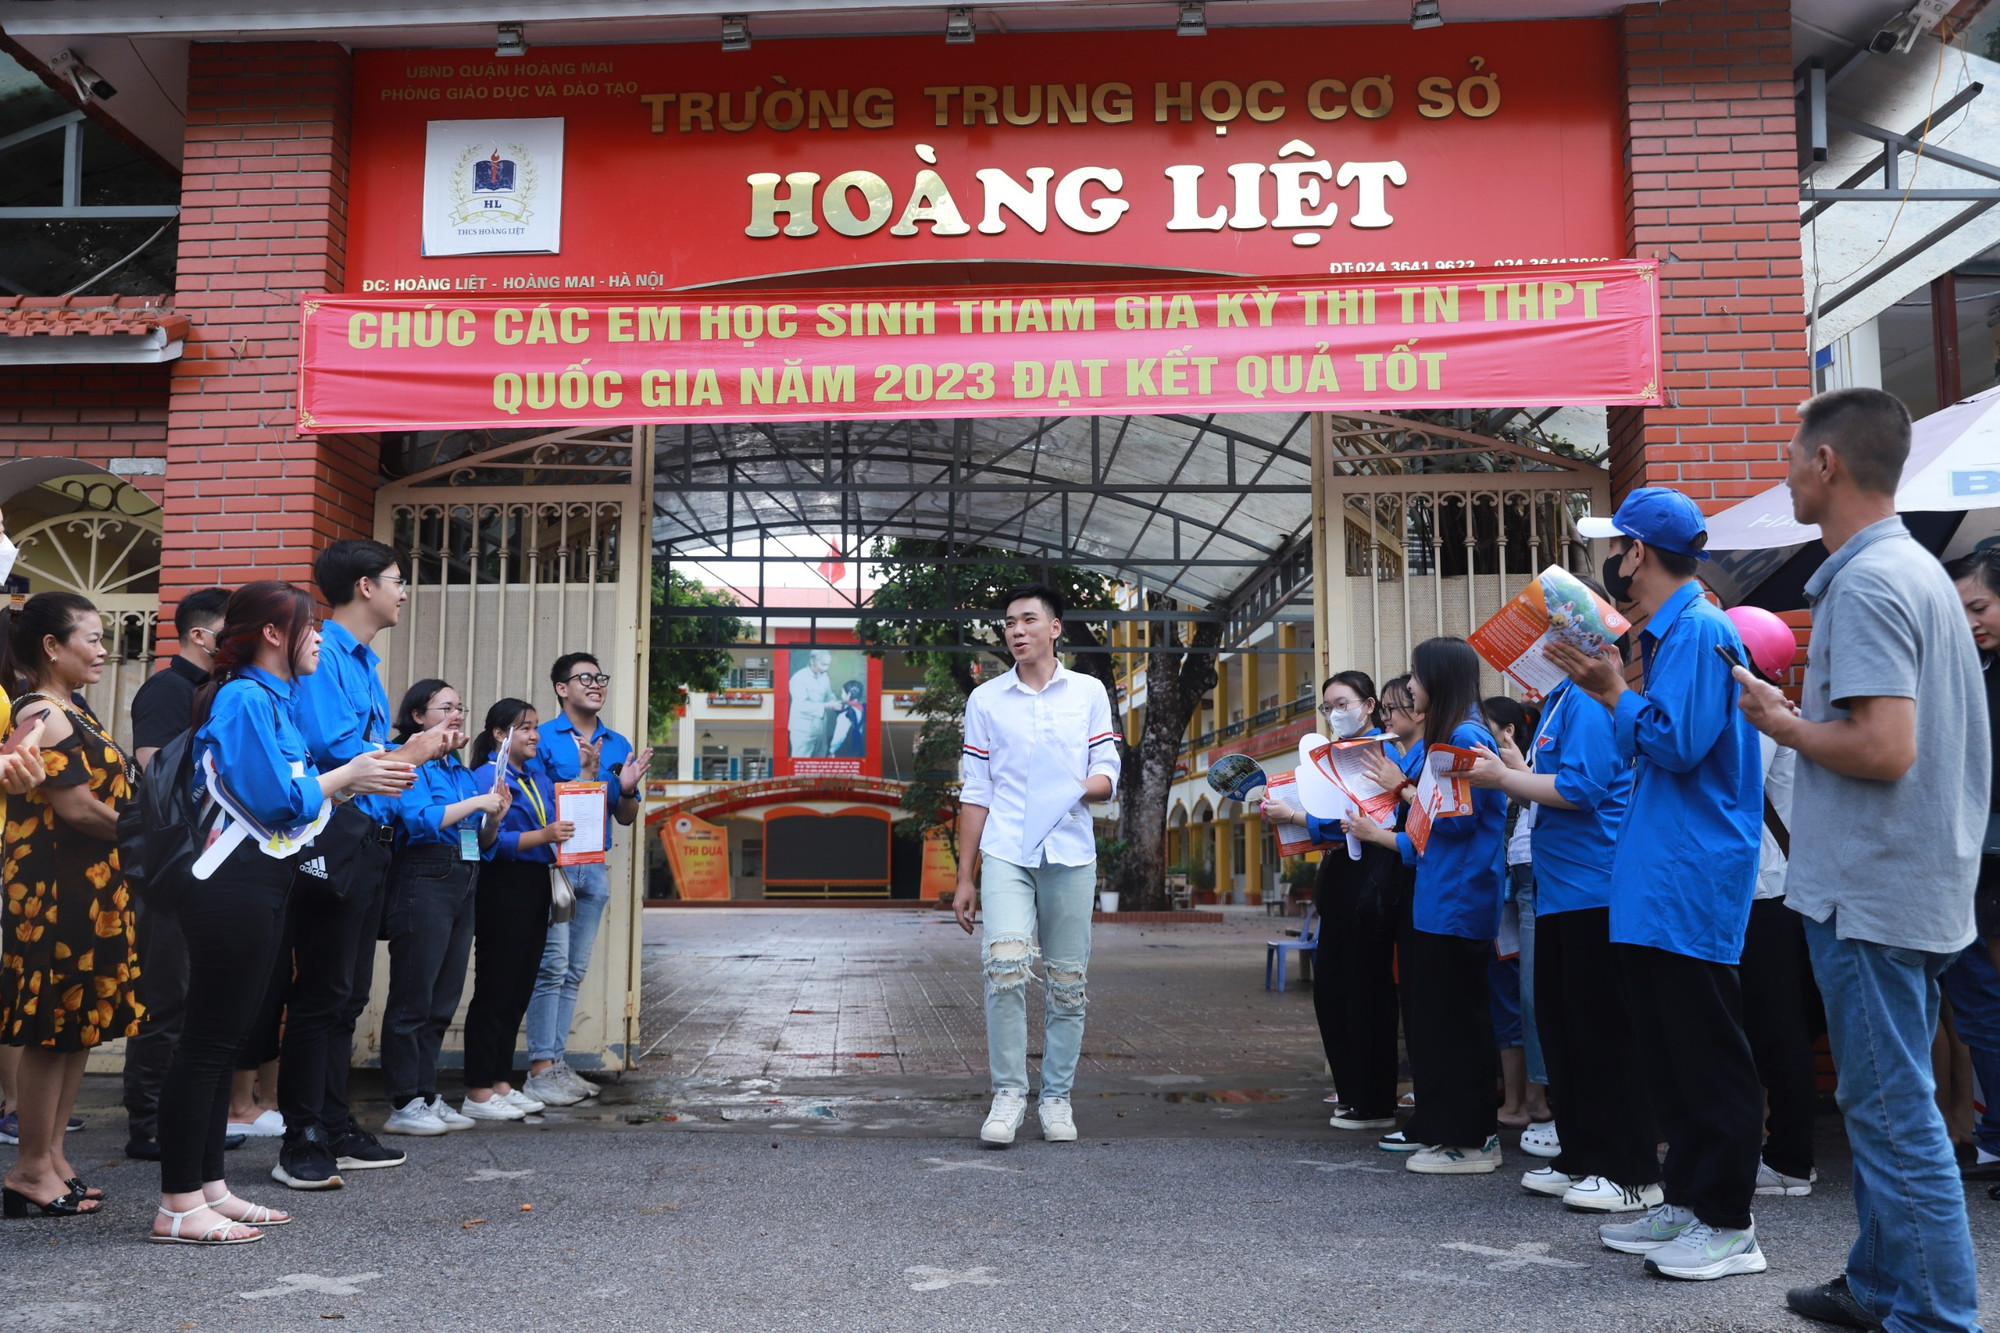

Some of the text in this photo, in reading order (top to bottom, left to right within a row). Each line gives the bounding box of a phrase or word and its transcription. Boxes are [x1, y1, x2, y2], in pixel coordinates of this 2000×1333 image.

[406, 60, 614, 80] UBND QUẬN HOÀNG MAI
[381, 84, 441, 101] PHÒNG
[446, 83, 489, 100] GIÁO
[493, 85, 529, 102] DỤC
[534, 82, 557, 97] VÀ
[604, 82, 638, 98] TẠO
[640, 56, 1500, 136] TRƯỜNG TRUNG HỌC CƠ SỞ
[744, 139, 1407, 246] HOÀNG LIỆT
[484, 200, 502, 208] HL
[458, 226, 525, 236] THCS HOÀNG LIỆT
[362, 279, 390, 292] ĐC:
[394, 276, 450, 291] HOÀNG
[455, 275, 487, 293] LIỆT
[503, 272, 560, 290] HOÀNG
[565, 276, 595, 288] MAI
[609, 272, 631, 288] HÀ
[636, 271, 664, 291] NỘI
[348, 281, 1603, 349] CHÚC CÁC EM HỌC SINH THAM GIA KỲ THI TN THPT
[492, 338, 1447, 414] QUỐC GIA NĂM 2023 ĐẠT KẾT QUẢ TỐT
[299, 864, 328, 879] adidas
